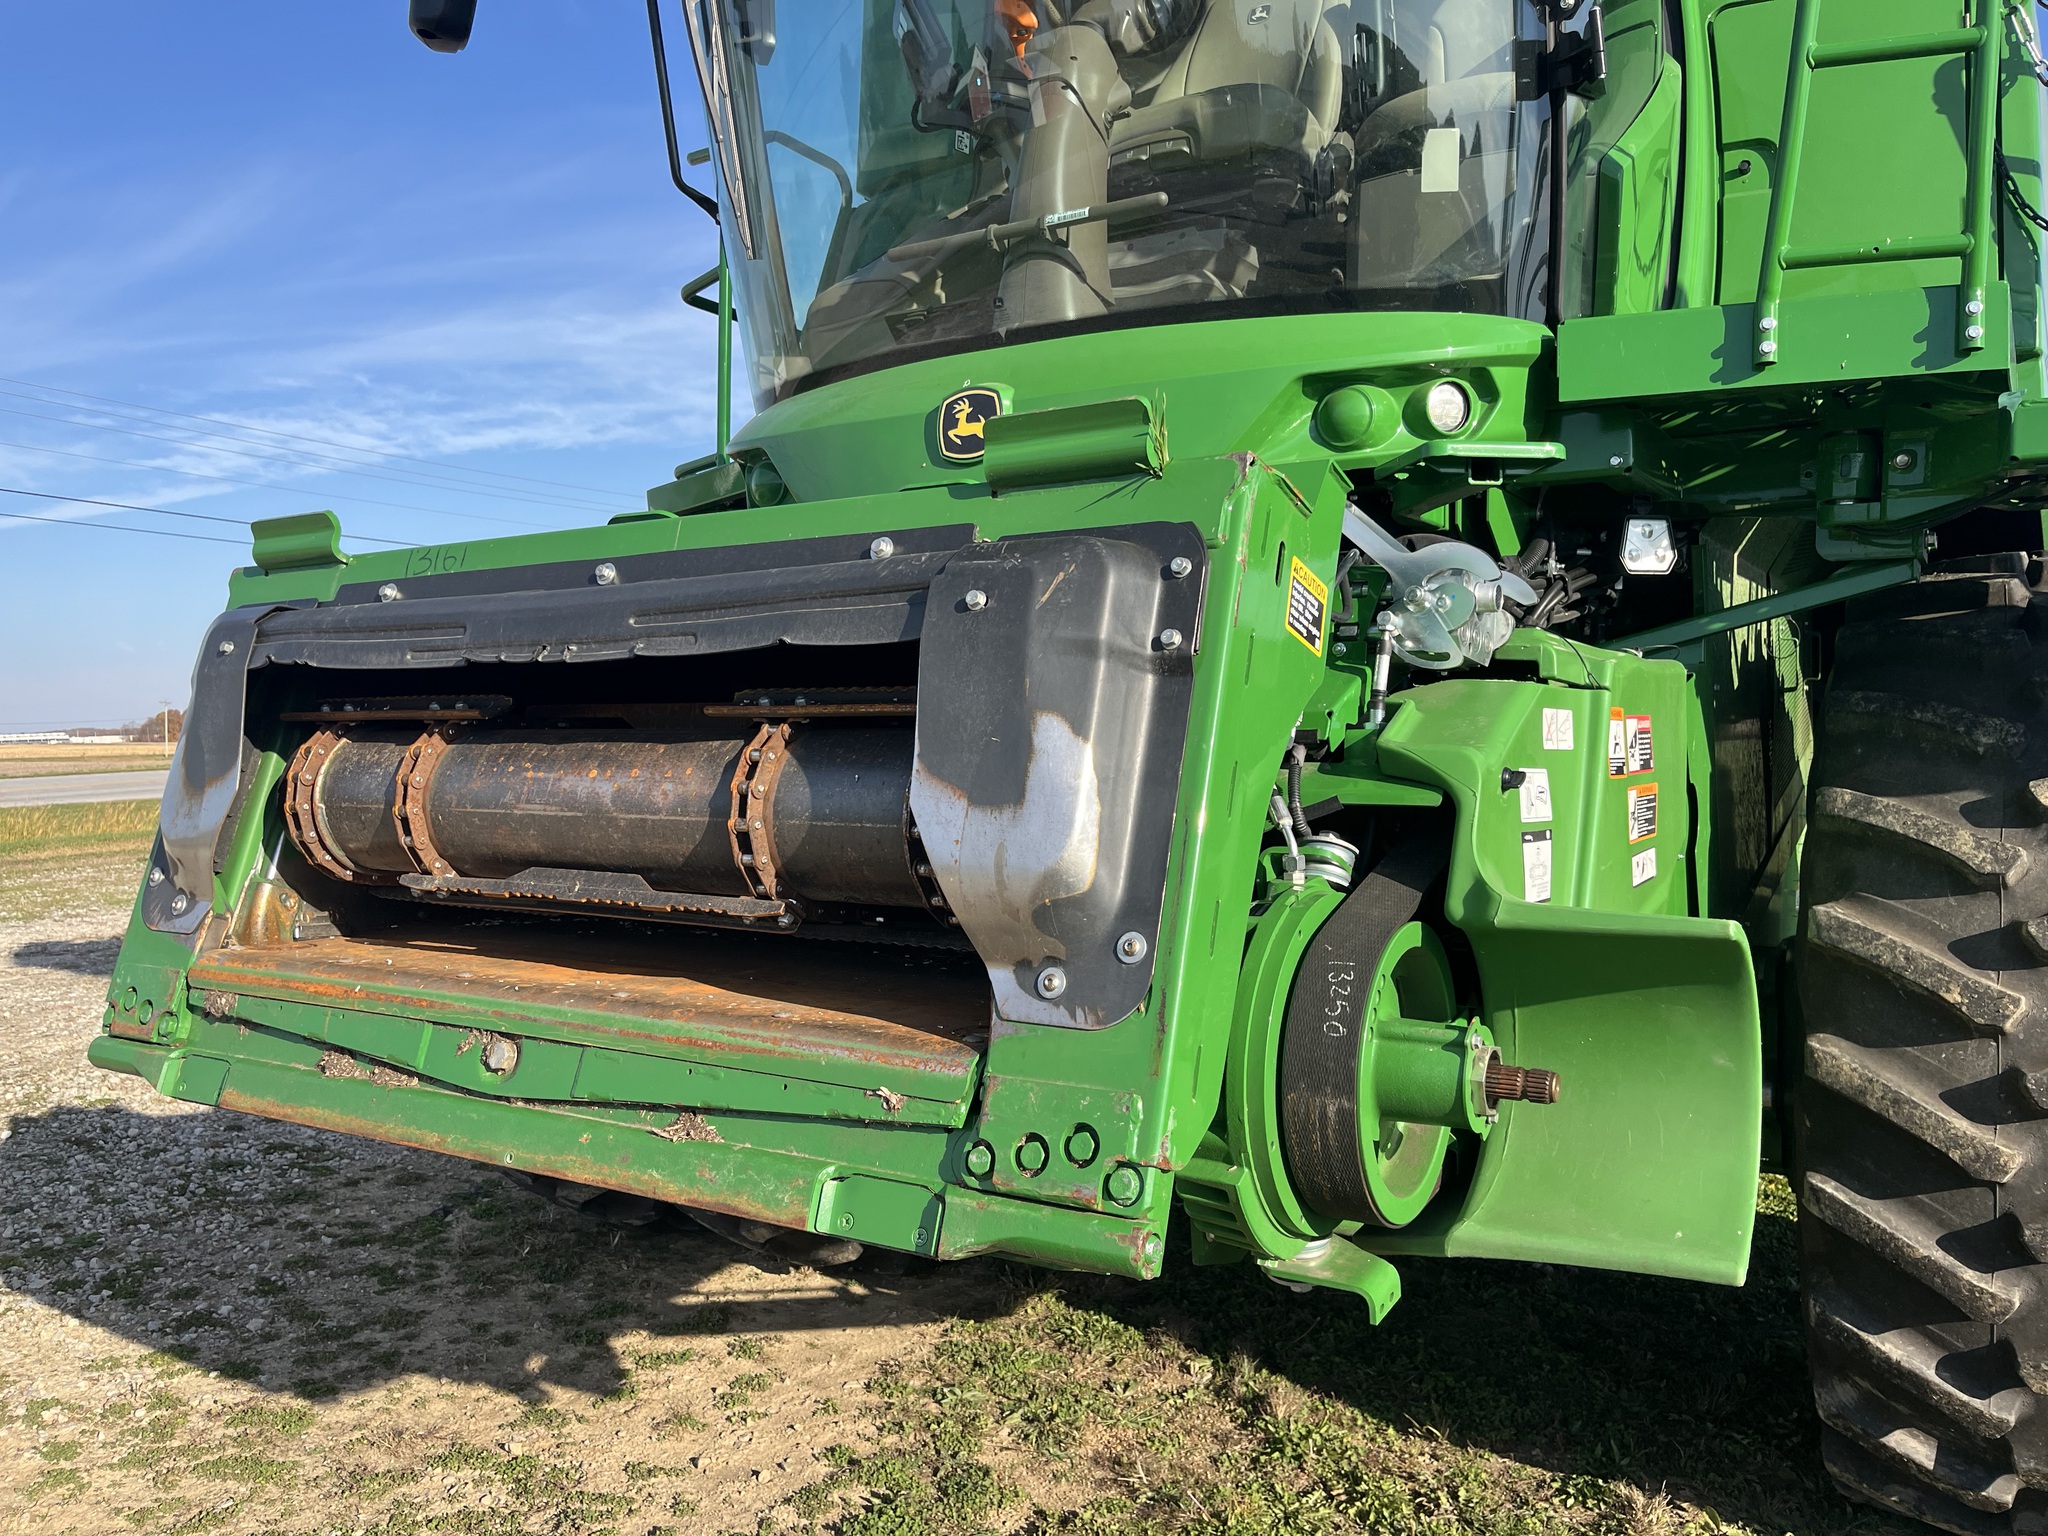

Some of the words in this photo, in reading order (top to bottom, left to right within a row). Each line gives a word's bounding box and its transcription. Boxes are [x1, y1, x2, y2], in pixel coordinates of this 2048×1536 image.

[405, 545, 468, 578] 13161
[1298, 567, 1326, 600] CAUTION
[1323, 961, 1355, 1037] 13250
